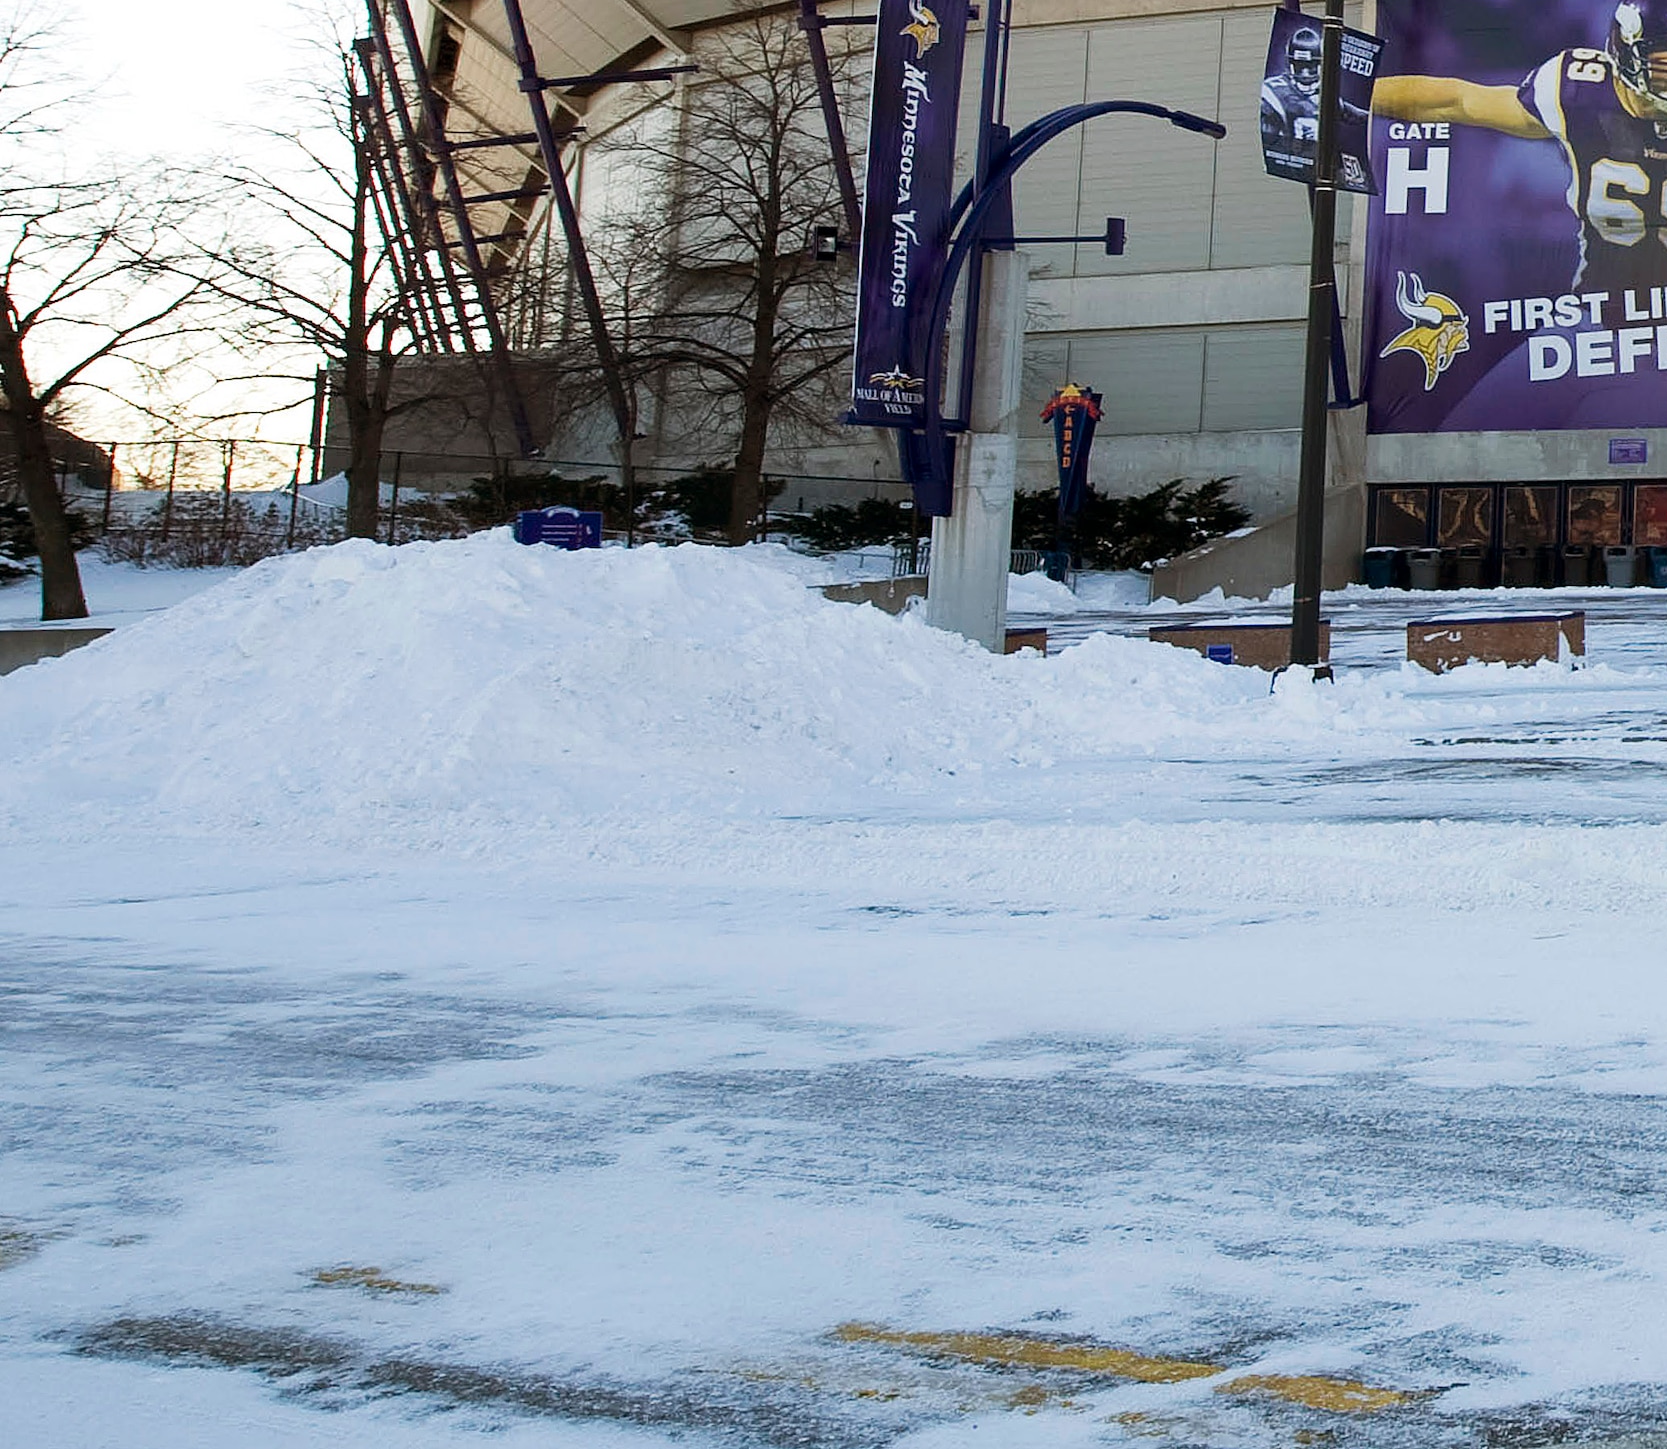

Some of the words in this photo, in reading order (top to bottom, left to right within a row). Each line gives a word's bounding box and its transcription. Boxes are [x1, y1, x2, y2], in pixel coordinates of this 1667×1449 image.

[1389, 123, 1450, 141] GATE
[1384, 147, 1449, 214] H
[1484, 292, 1609, 334] FIRST
